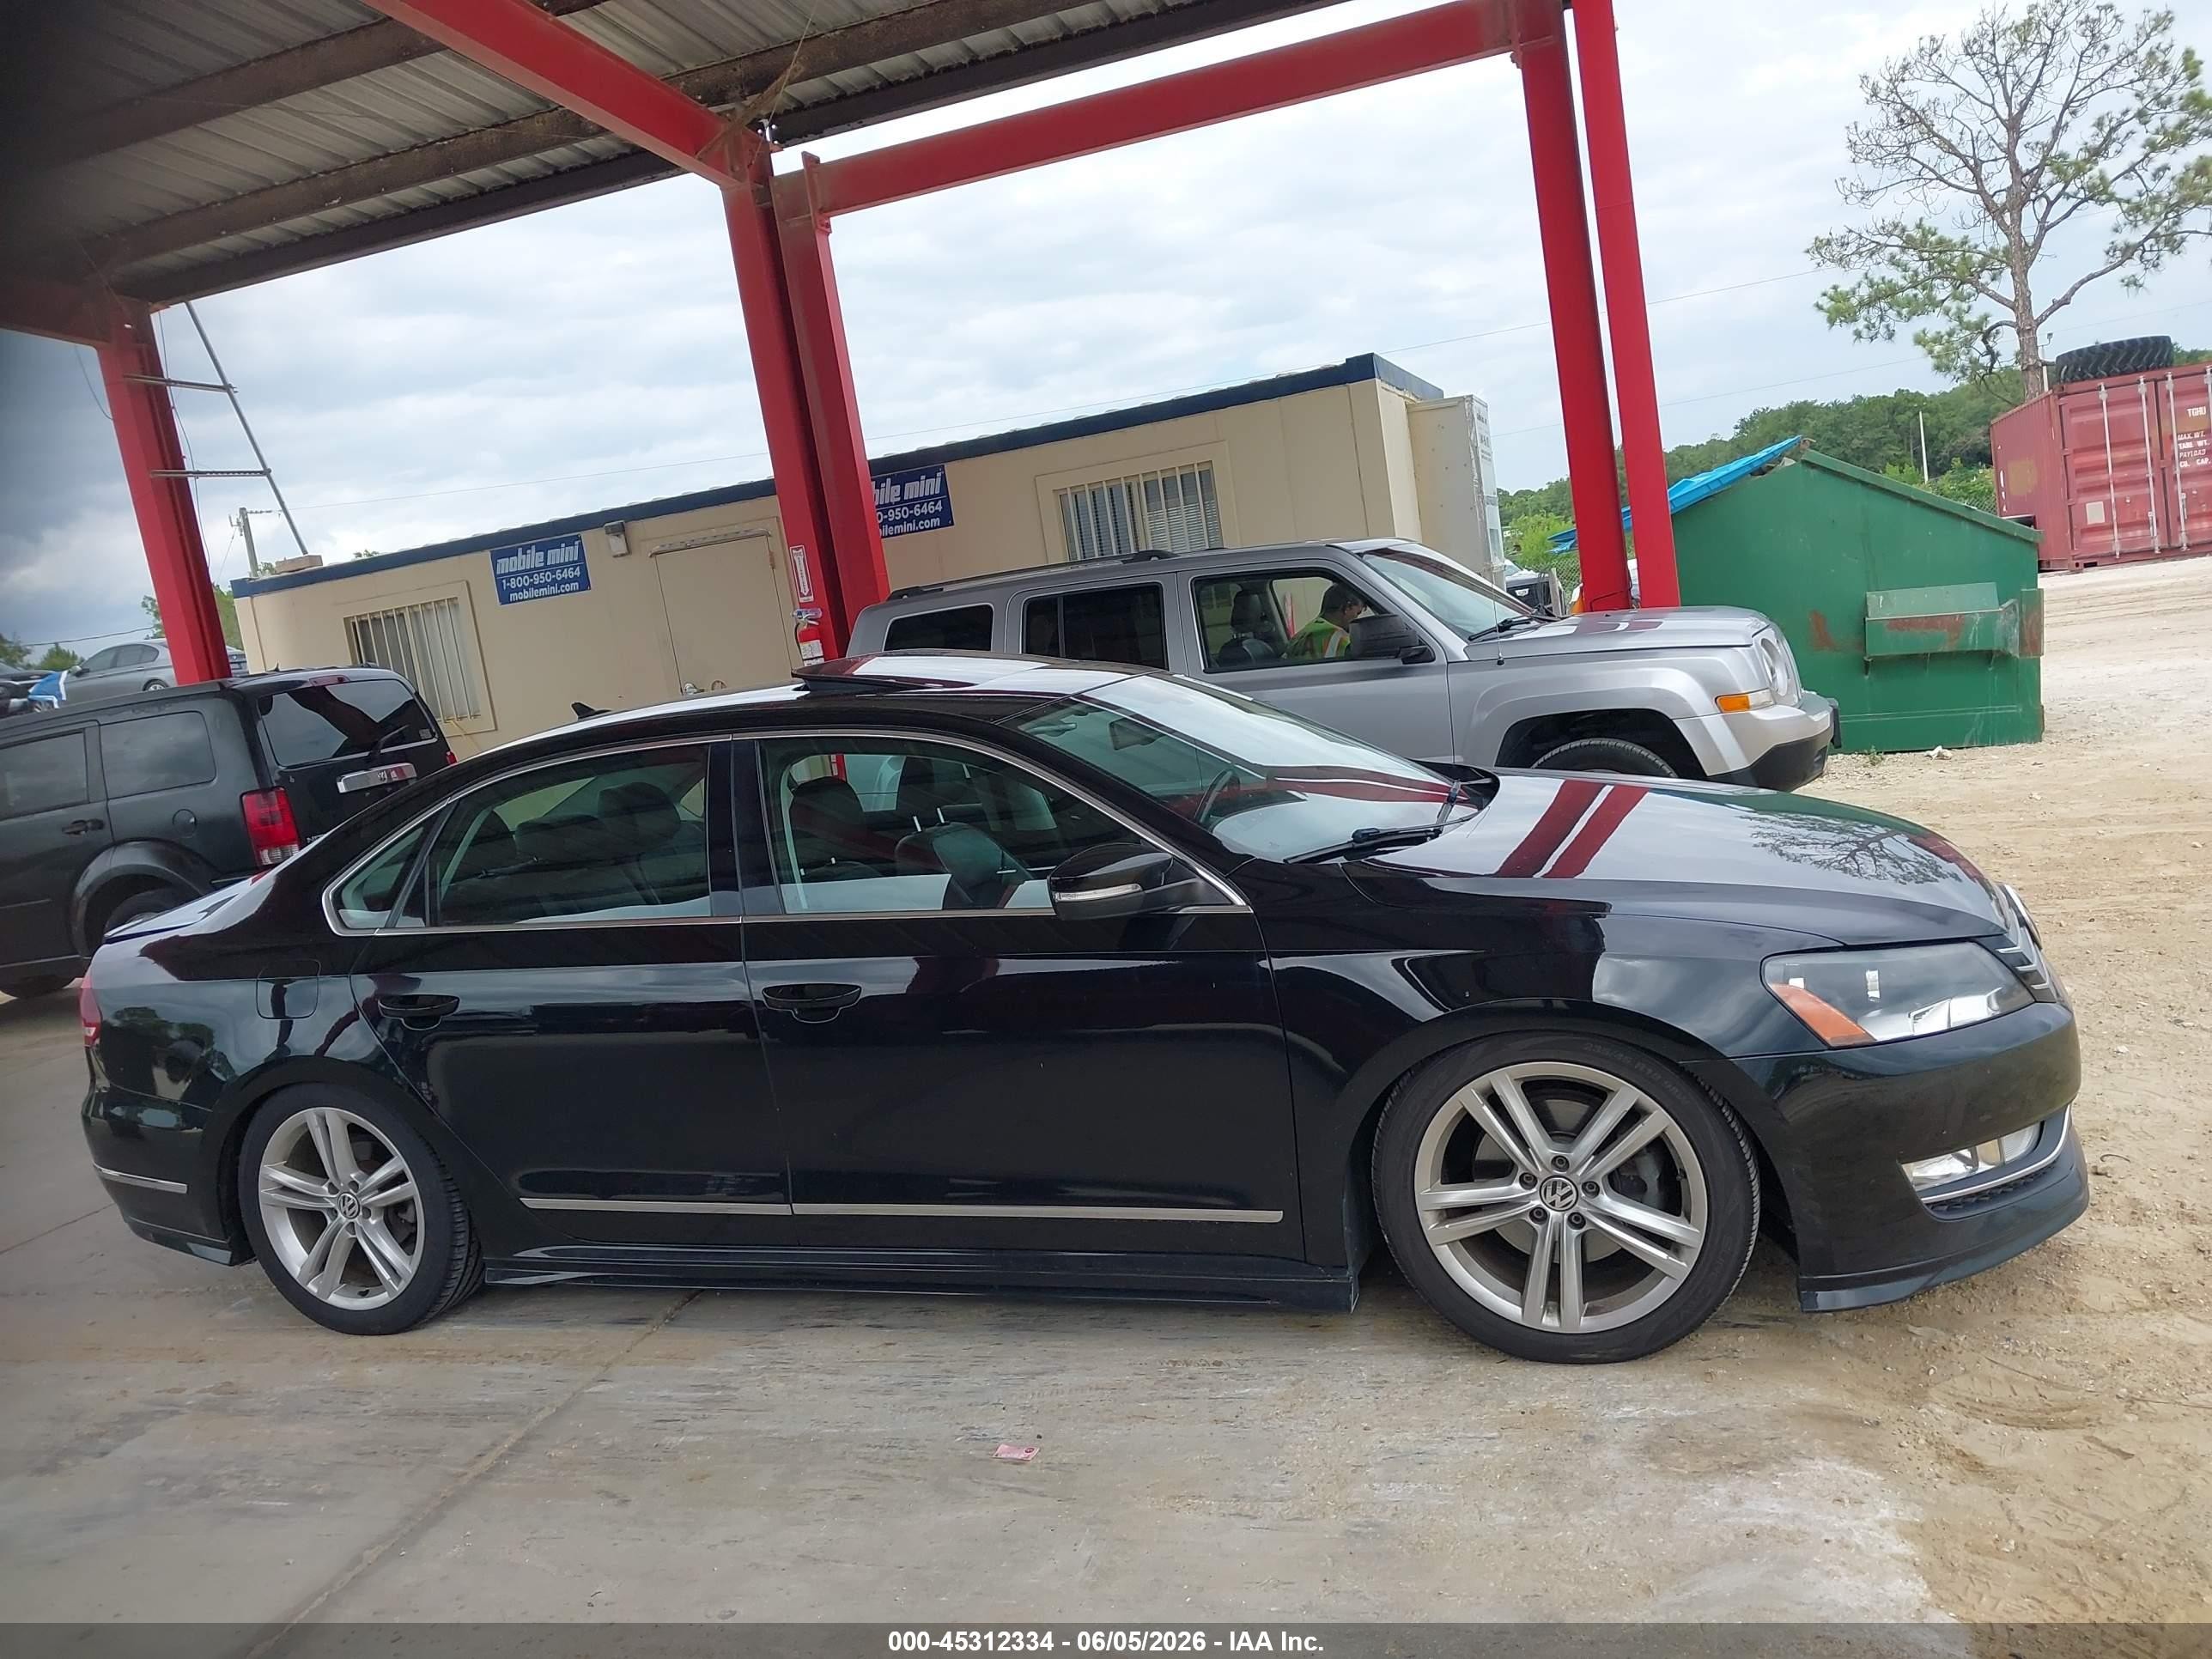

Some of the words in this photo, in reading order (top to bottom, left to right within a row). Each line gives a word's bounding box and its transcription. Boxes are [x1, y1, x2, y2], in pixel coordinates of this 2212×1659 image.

[904, 471, 942, 500] mini
[496, 545, 544, 574] mobile
[547, 540, 581, 565] mini
[501, 566, 580, 591] 1-800-950-6464
[510, 581, 580, 602] mobilemini.com
